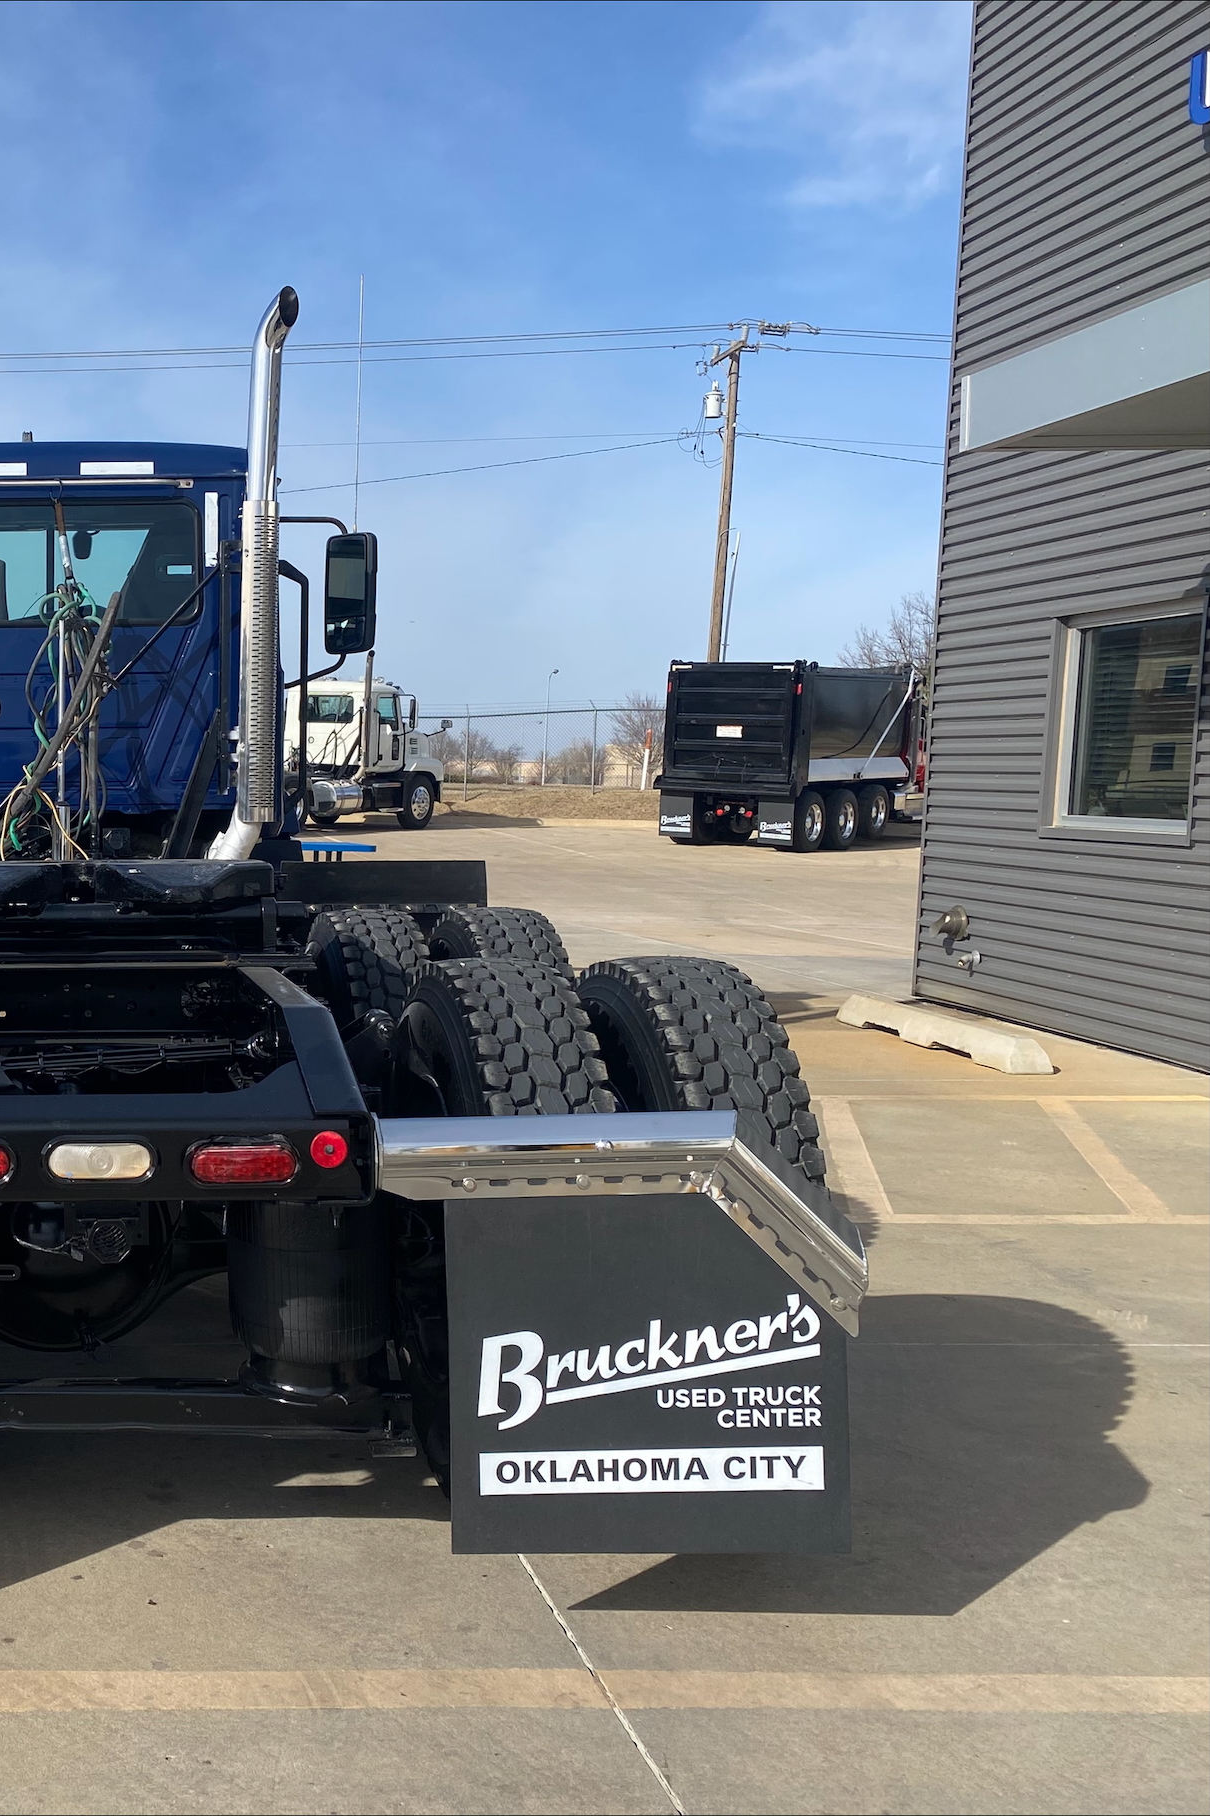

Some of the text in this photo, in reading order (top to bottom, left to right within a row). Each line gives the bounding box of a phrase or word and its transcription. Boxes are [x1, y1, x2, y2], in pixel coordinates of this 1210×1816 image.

[477, 1293, 821, 1431] Bruckner's
[657, 1385, 822, 1408] USED TRUCK
[717, 1408, 822, 1428] CENTER
[495, 1455, 807, 1484] OKLAHOMA CITY
